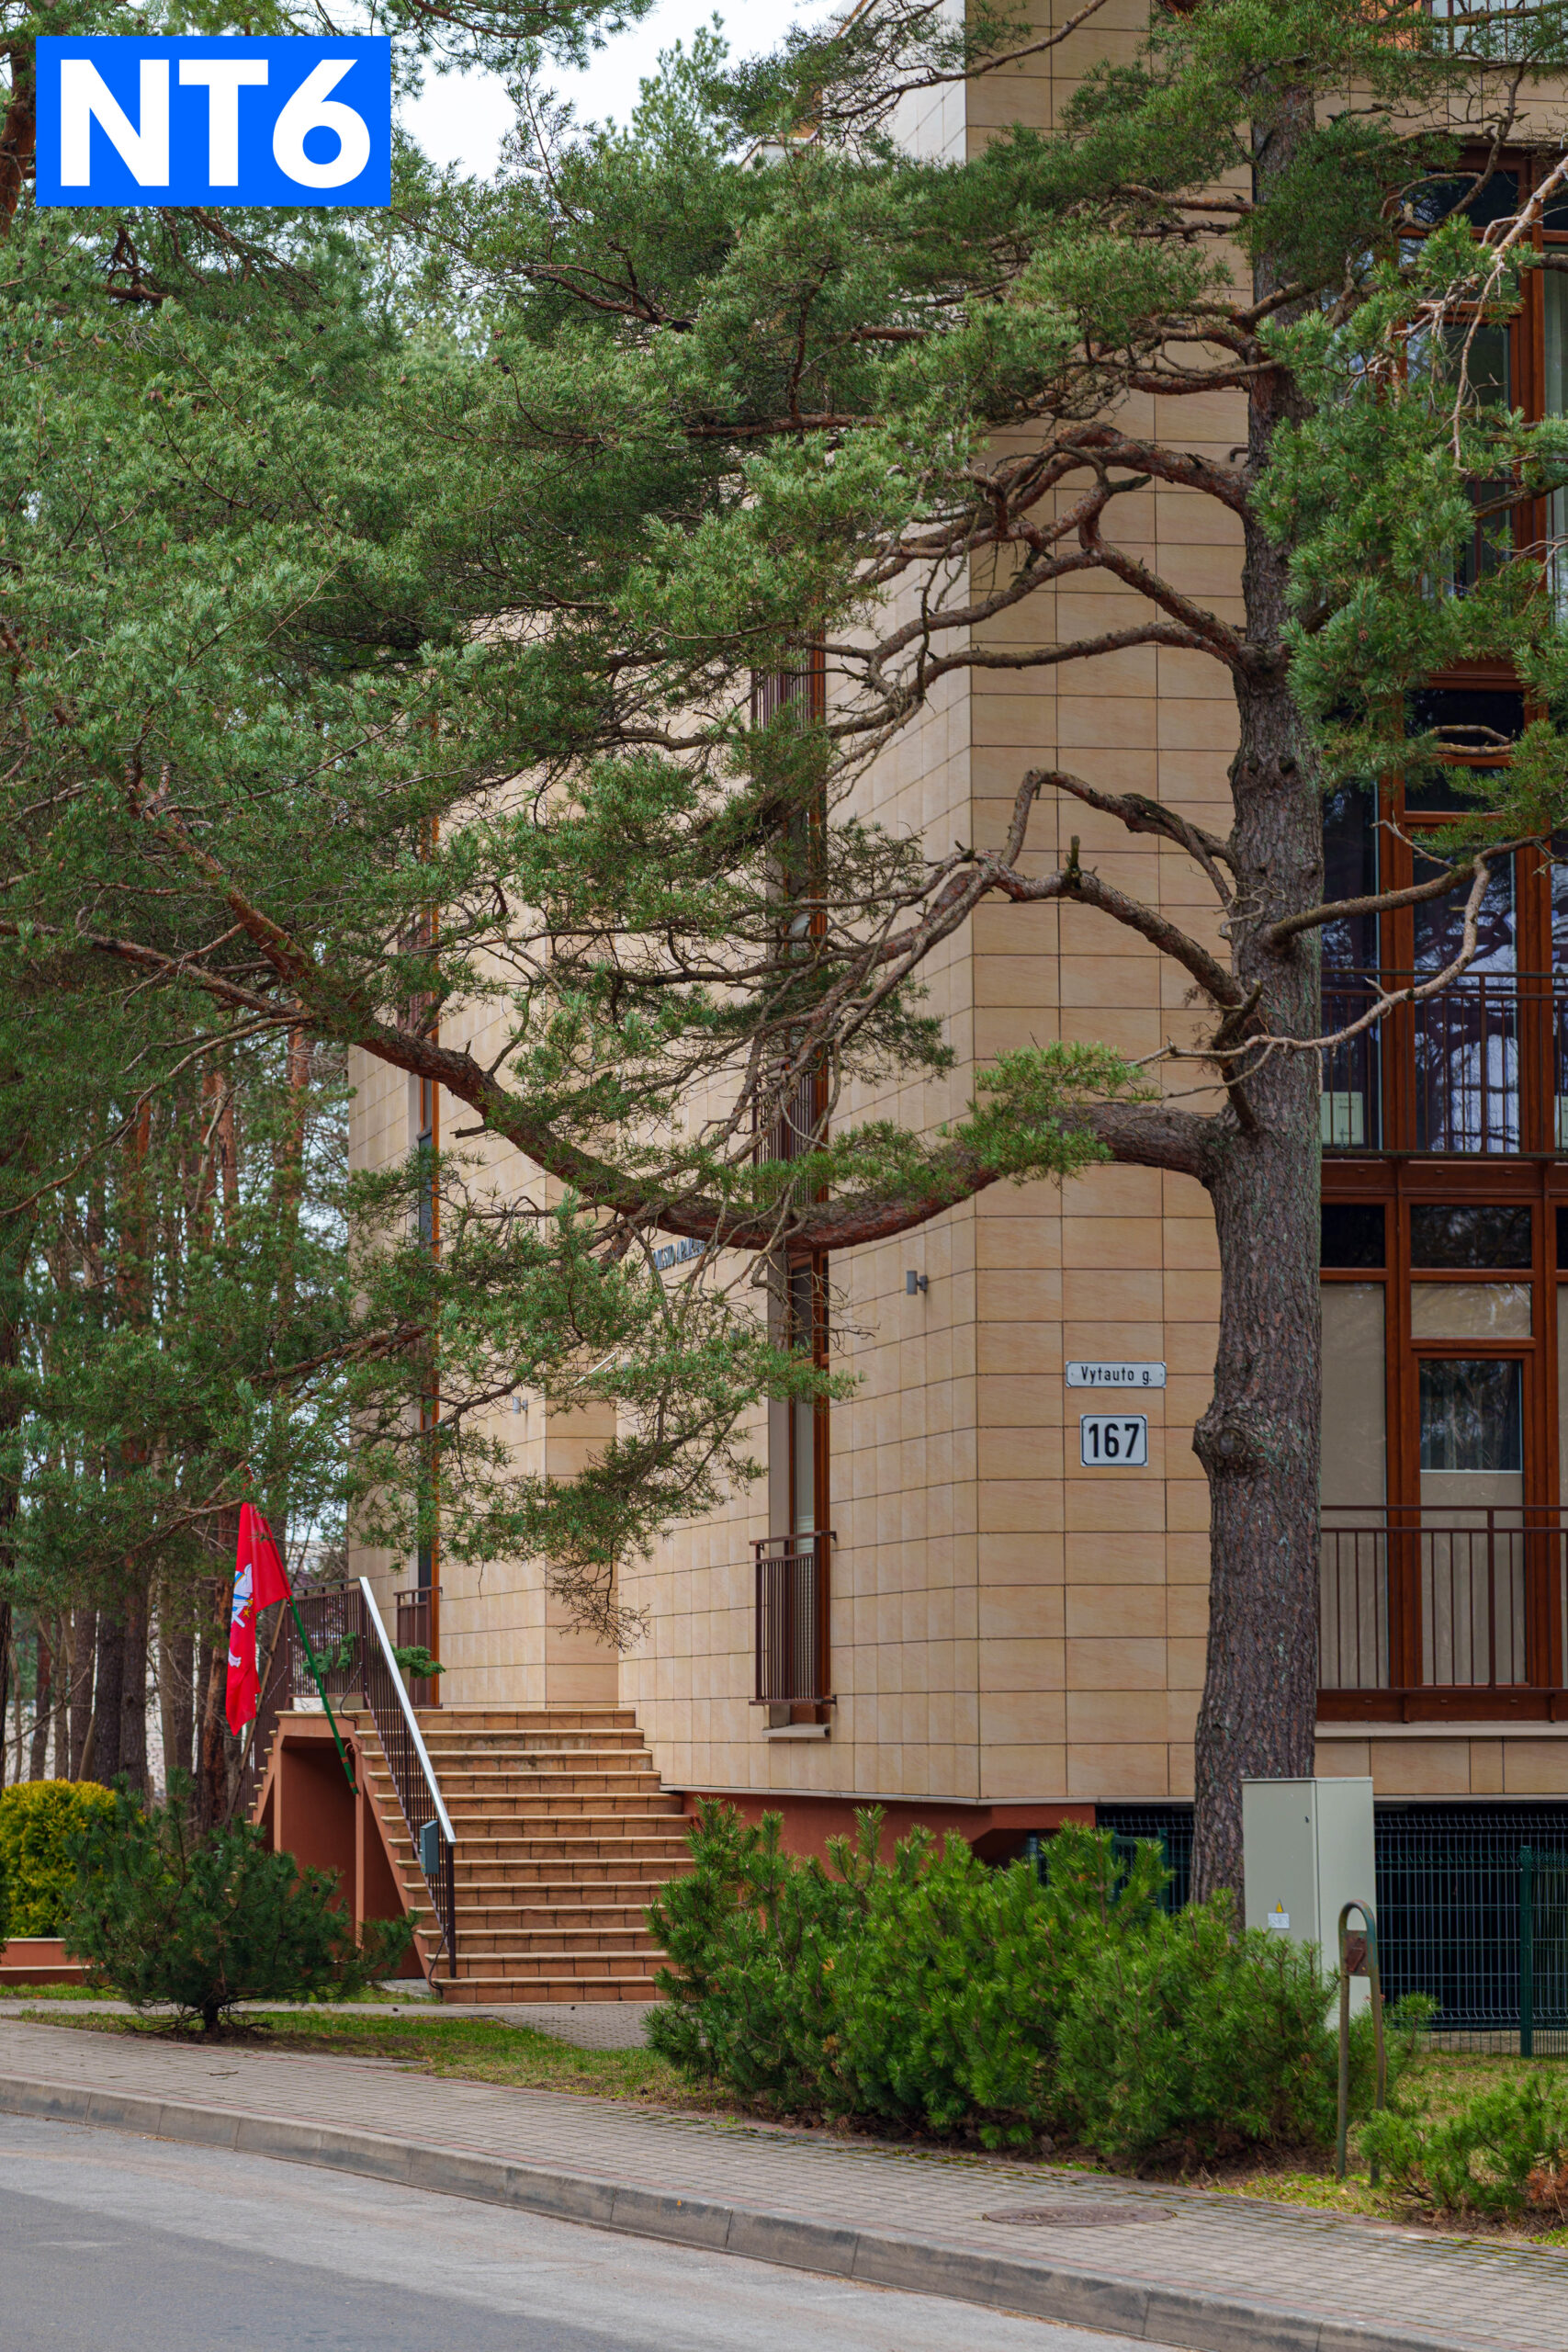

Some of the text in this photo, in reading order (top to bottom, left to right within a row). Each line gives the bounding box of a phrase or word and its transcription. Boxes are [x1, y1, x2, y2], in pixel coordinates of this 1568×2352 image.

[1081, 1365, 1153, 1385] Vytauto g.
[1089, 1423, 1140, 1458] 167
